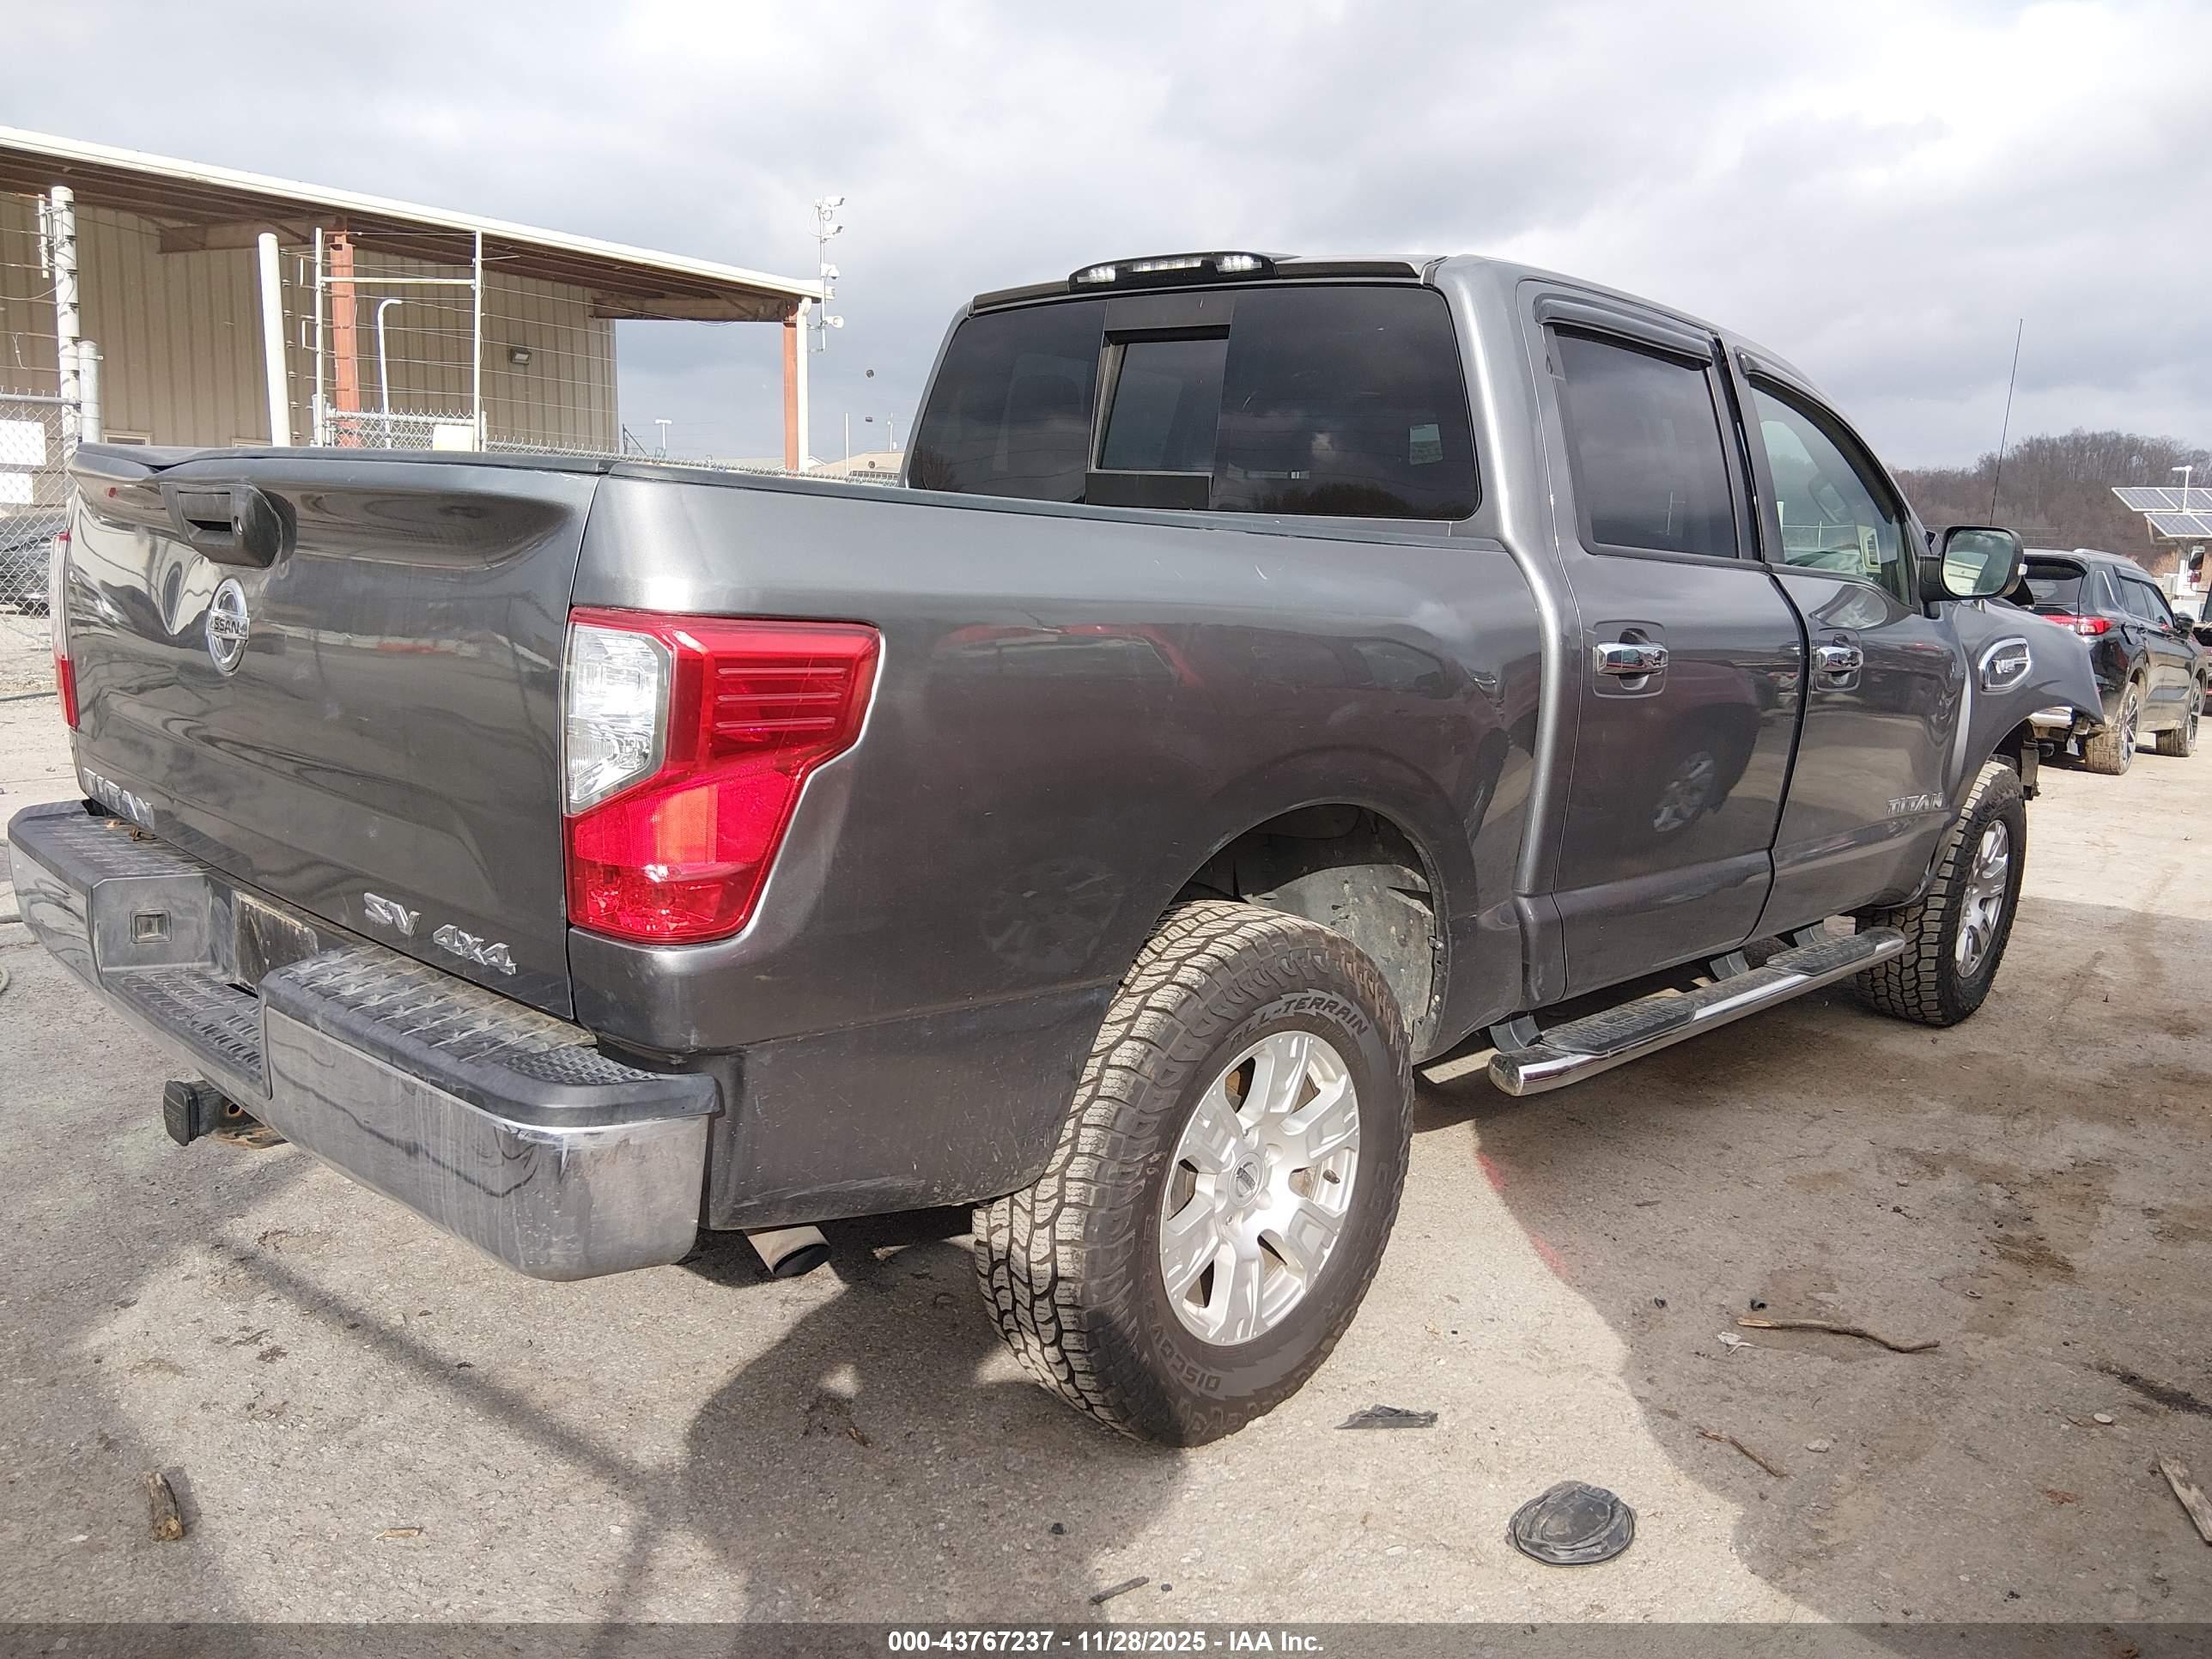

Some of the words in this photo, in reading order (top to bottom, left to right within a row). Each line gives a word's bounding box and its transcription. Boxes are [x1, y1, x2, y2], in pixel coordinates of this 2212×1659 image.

[1887, 792, 1943, 816] TITAN
[364, 892, 422, 937] SV
[1228, 996, 1368, 1051] ALL-TERRAIN
